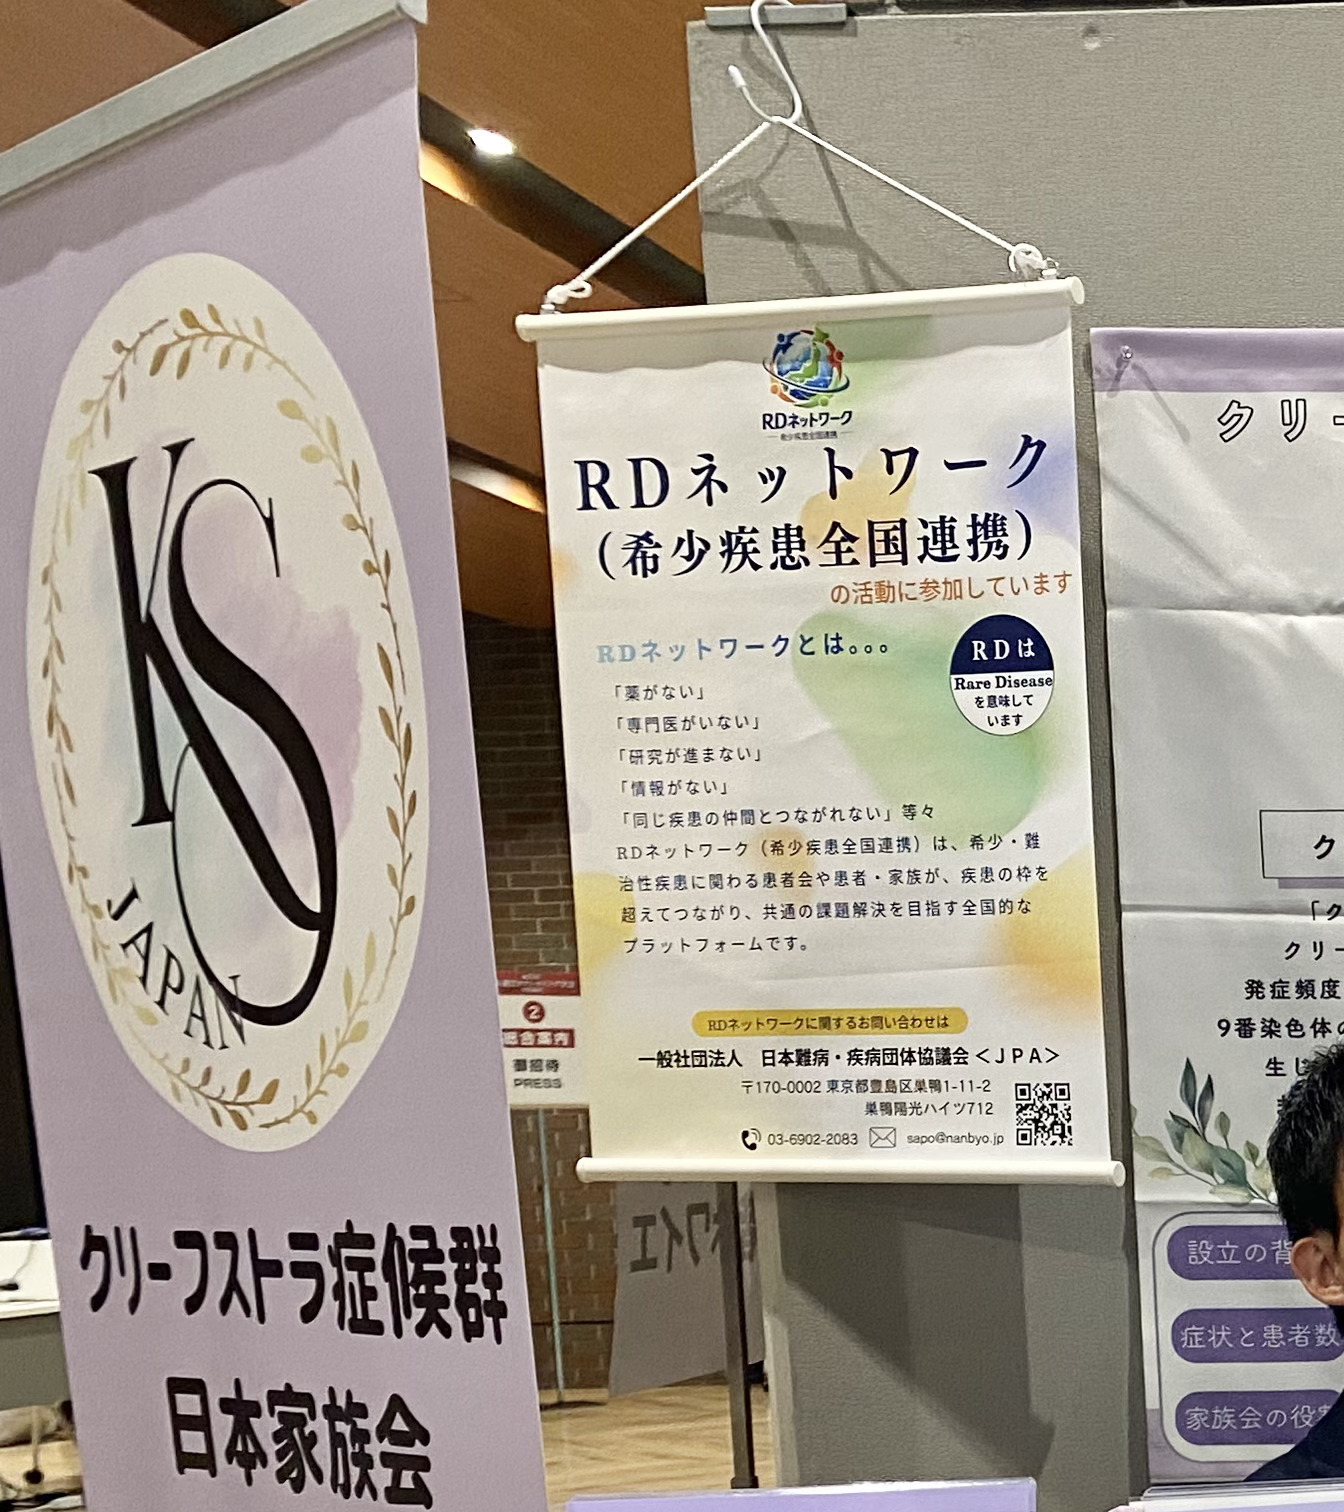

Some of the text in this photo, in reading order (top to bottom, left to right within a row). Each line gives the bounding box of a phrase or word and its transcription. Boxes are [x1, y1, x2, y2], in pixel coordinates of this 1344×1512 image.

[762, 411, 852, 430] RDネットワーク
[574, 433, 1048, 511] RDネットワーク
[598, 510, 1035, 580] （希少疾患全国連携）
[831, 572, 1072, 605] の活動に参加しています
[972, 637, 1036, 662] RDは
[613, 683, 705, 701] 「薬がない」
[954, 674, 1053, 691] Rare Disease
[974, 693, 1034, 708] を意味して
[616, 715, 760, 733] 「専門医がいない」
[987, 713, 1023, 728] います
[618, 746, 762, 766] 「研究が進まない」
[620, 779, 728, 798] 「情報がない」
[623, 936, 810, 954] プラットフォームです。
[105, 879, 248, 1049] JAPAN
[638, 1049, 743, 1069] 一般社団法人
[514, 1078, 562, 1088] PRESS
[741, 1080, 821, 1095] 〒170-0002
[864, 1101, 994, 1117] 巣鴨陽光ハイツ712
[768, 1132, 858, 1146] 03-6902-2083
[906, 1132, 1004, 1146] sapo@nanbyo.jp
[80, 1219, 508, 1344] クリーフストラ症候群
[1180, 1321, 1340, 1349] 症状と患者数
[166, 1377, 434, 1508] 日本家族会
